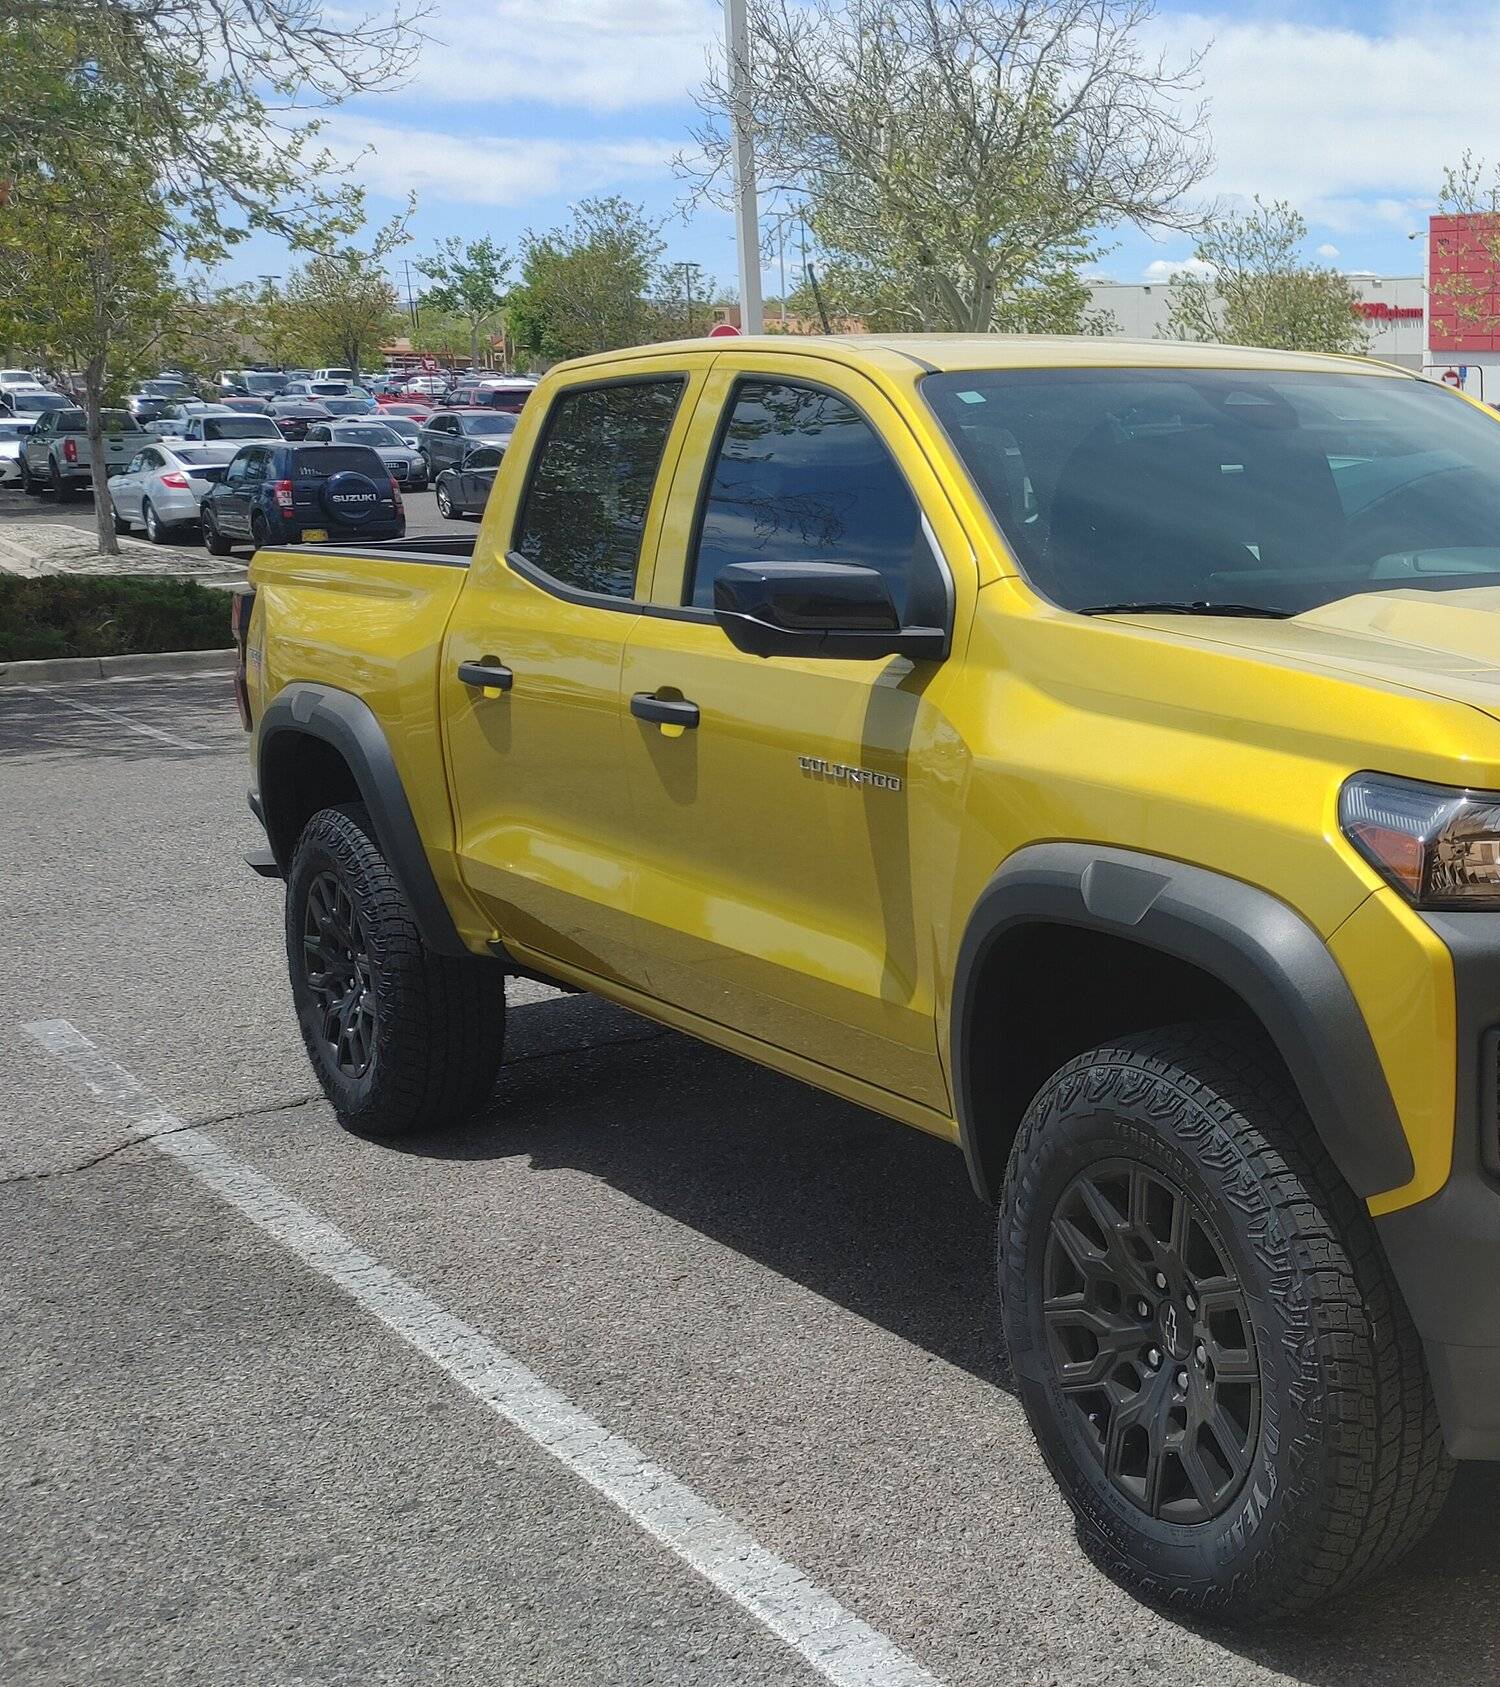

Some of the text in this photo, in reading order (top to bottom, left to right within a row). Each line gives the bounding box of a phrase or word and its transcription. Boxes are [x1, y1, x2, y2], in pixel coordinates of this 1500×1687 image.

[332, 493, 377, 503] SUZUKI
[798, 756, 902, 791] COLORADO
[1216, 1325, 1280, 1551] GOODYEAR
